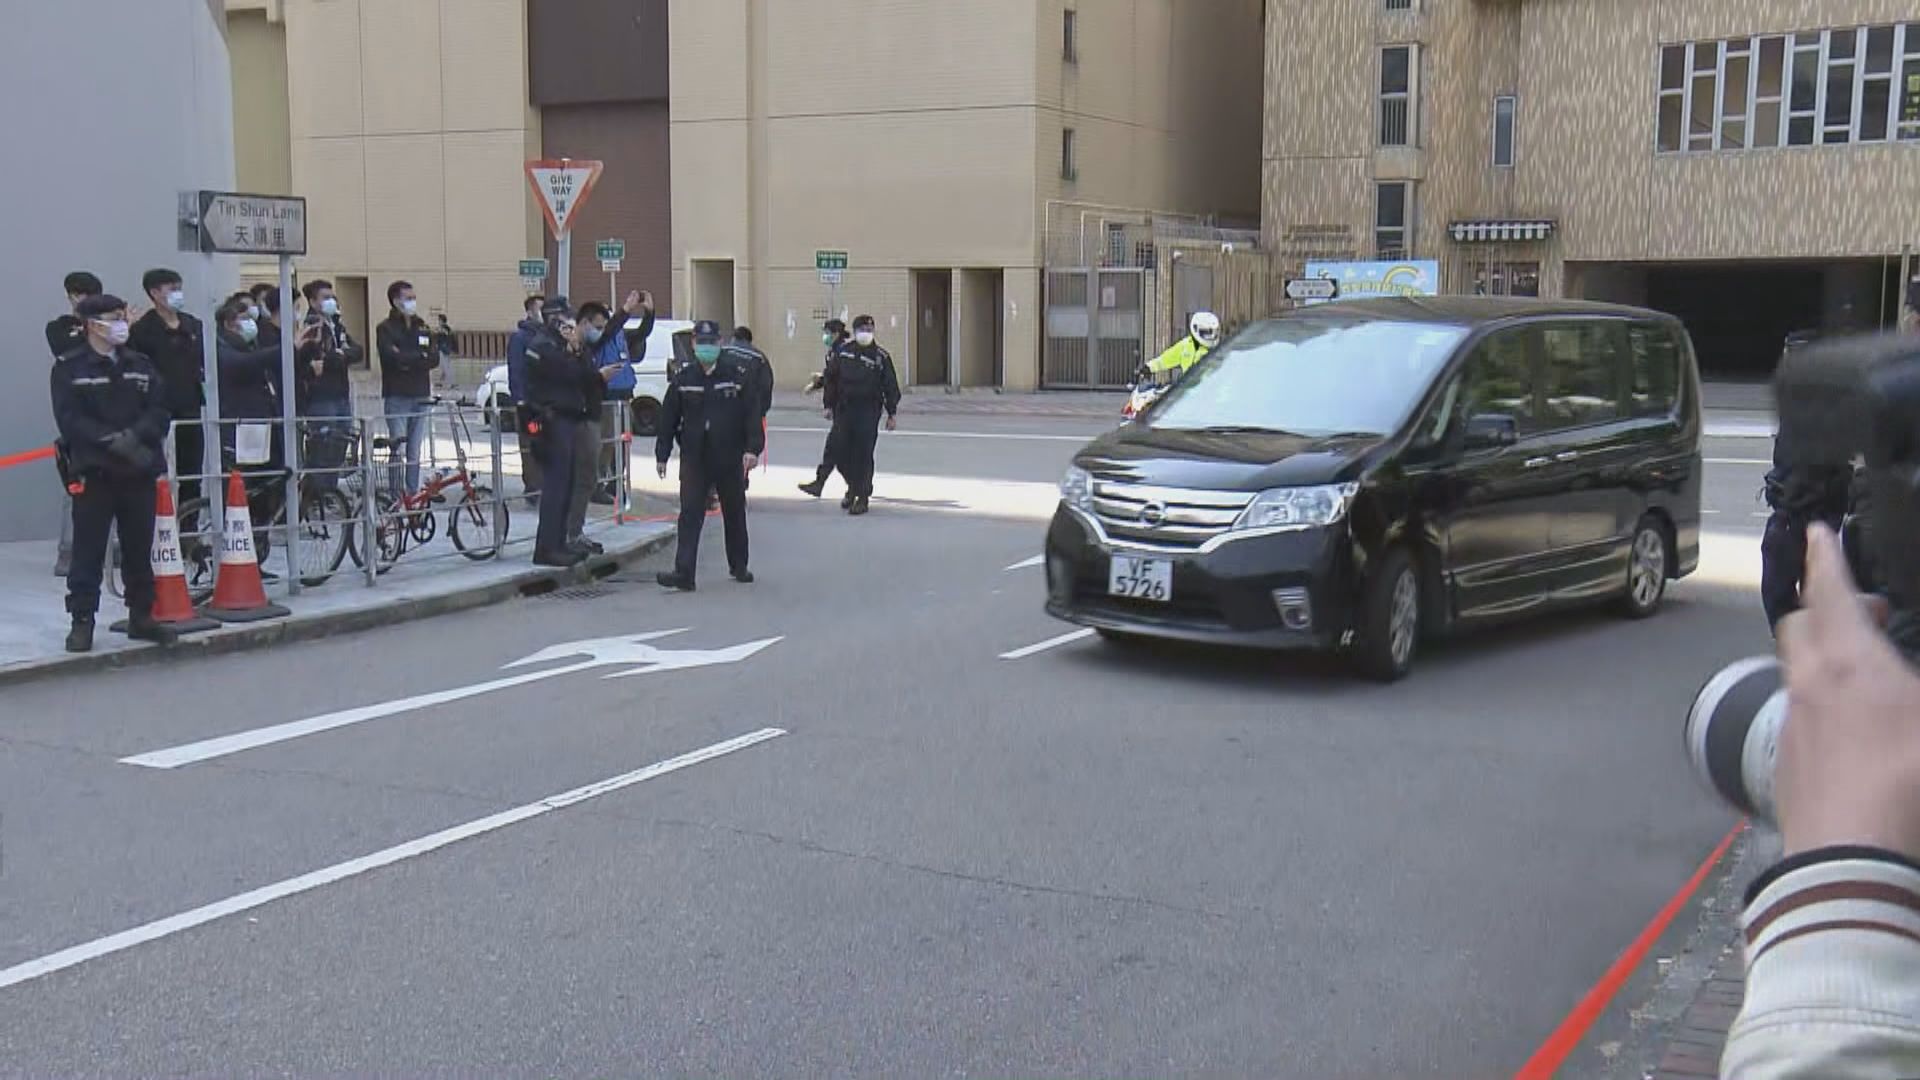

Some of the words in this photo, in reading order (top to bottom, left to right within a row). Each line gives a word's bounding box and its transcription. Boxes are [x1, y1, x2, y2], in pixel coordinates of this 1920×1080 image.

[550, 174, 573, 185] GIVE
[551, 185, 572, 196] WAY
[216, 199, 236, 216] Tin
[239, 201, 270, 218] Shun
[221, 537, 251, 552] LICE
[151, 547, 178, 564] LICE
[1115, 575, 1166, 599] 5726
